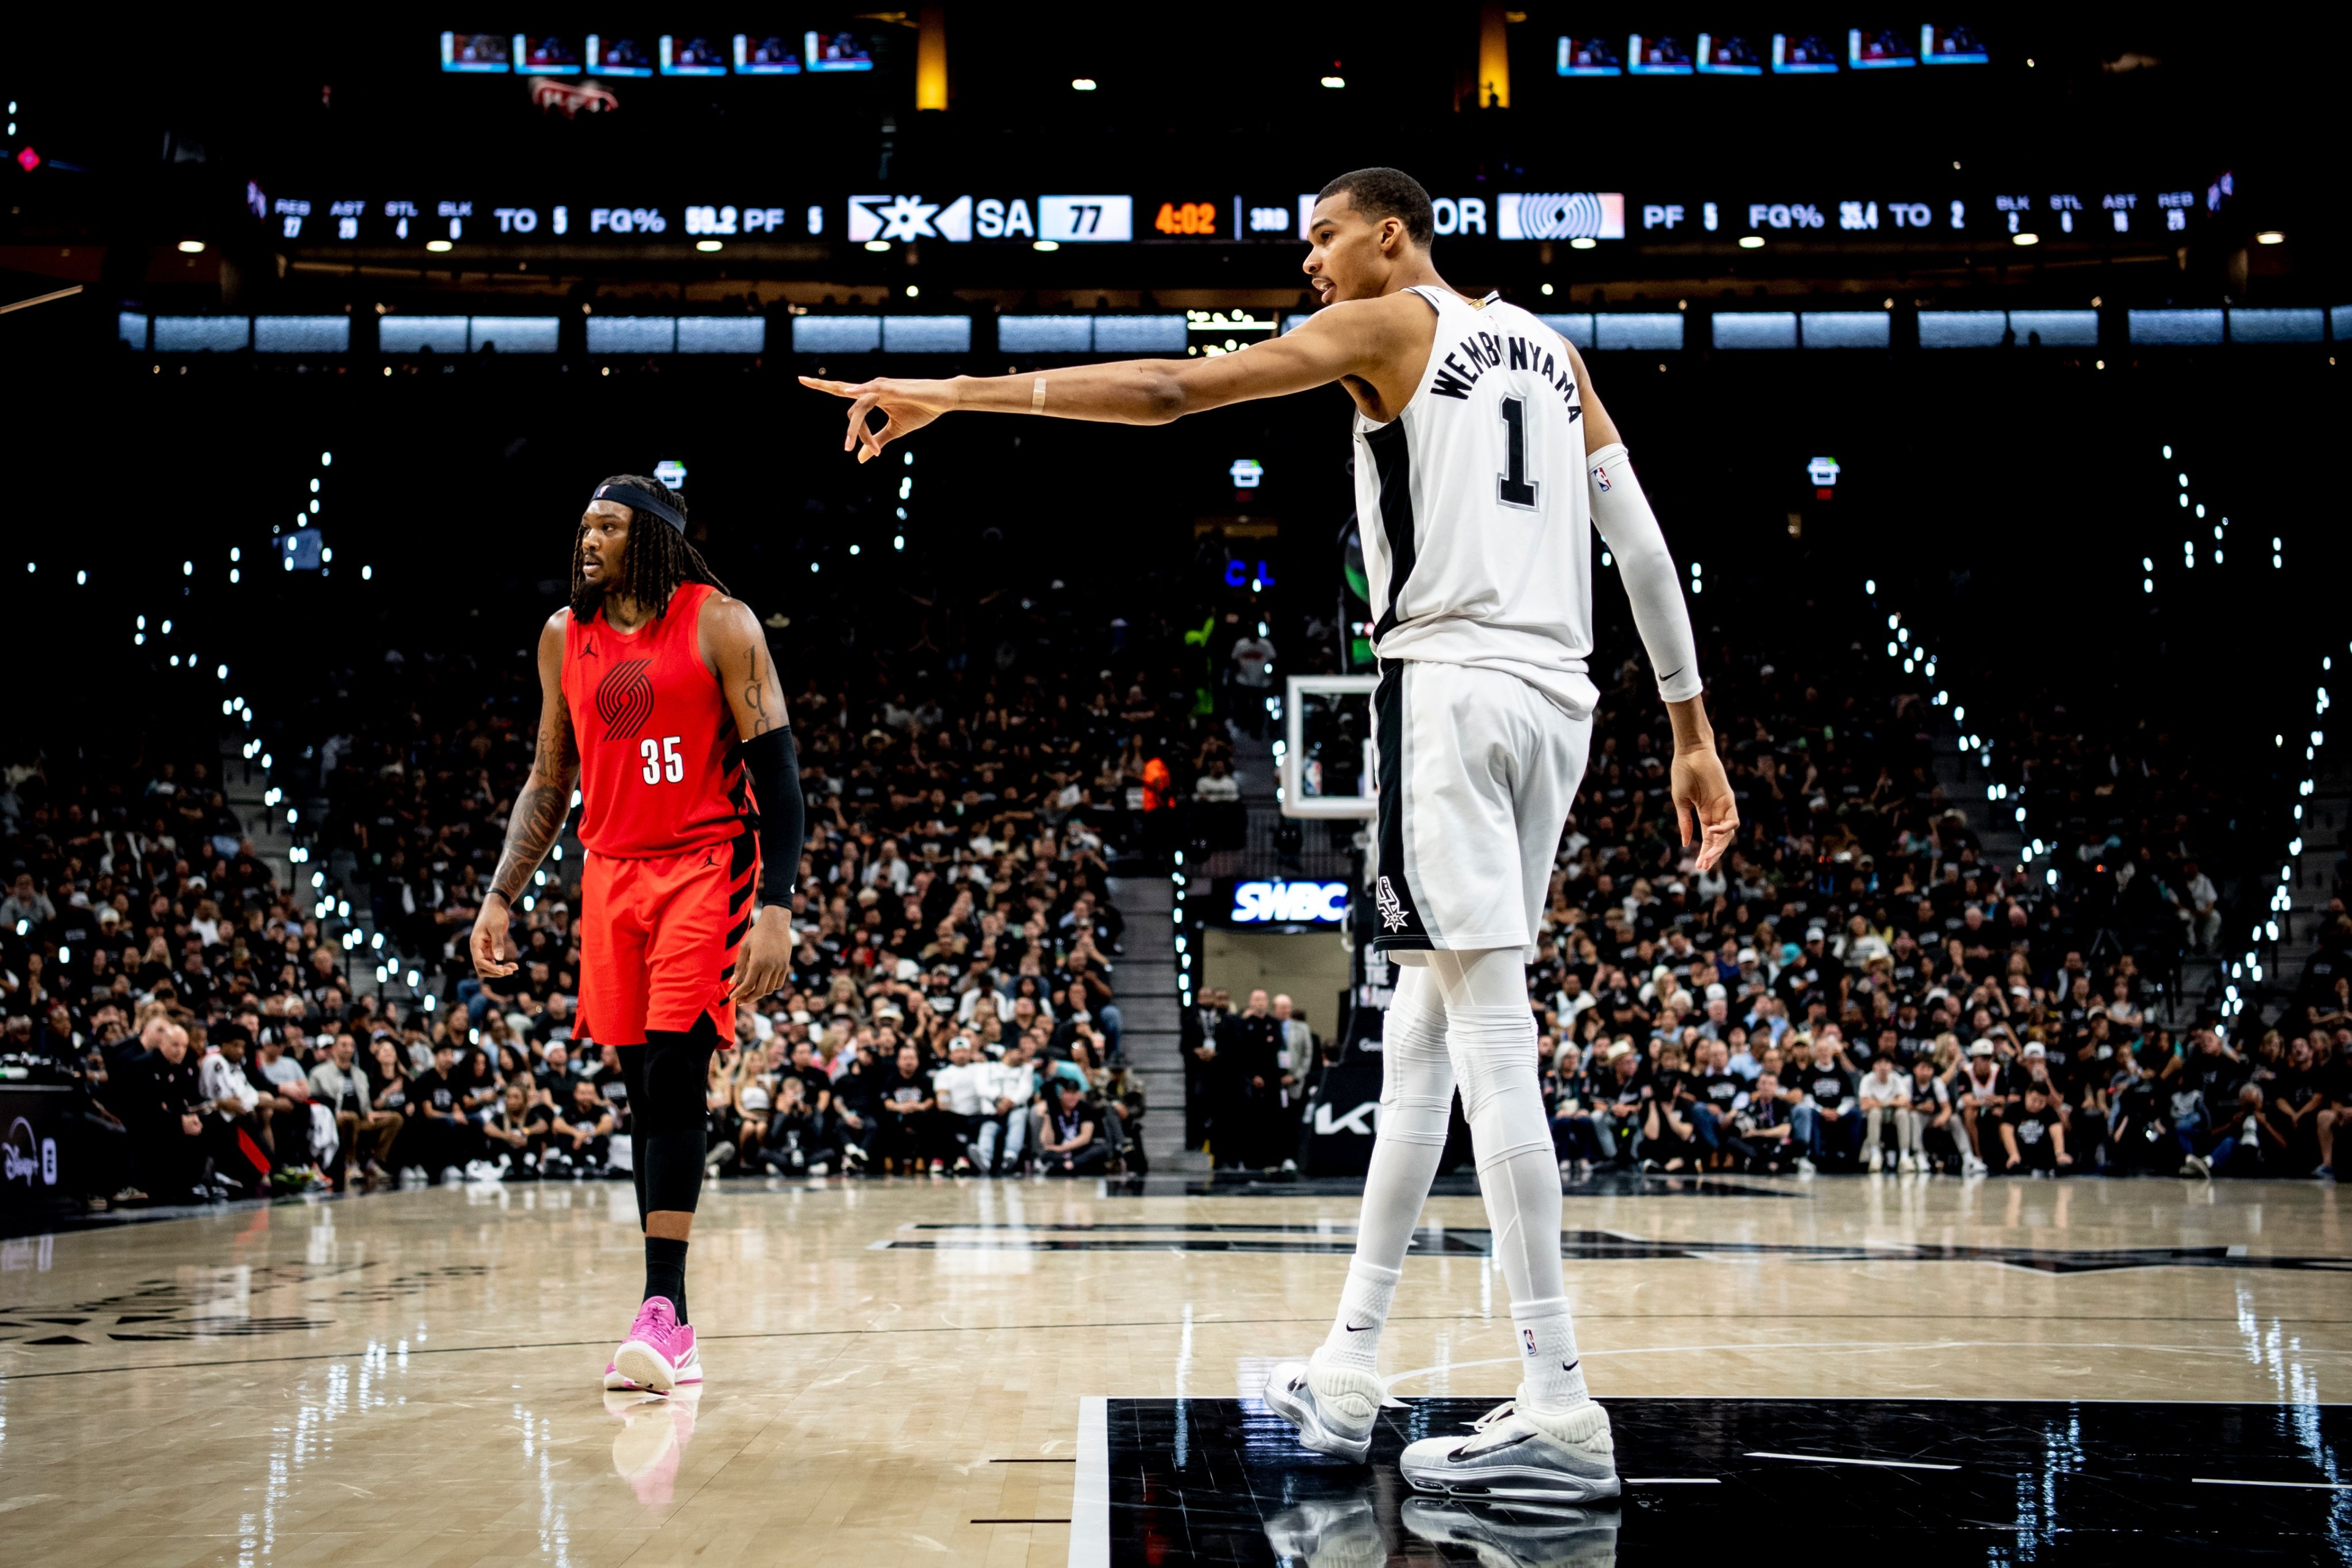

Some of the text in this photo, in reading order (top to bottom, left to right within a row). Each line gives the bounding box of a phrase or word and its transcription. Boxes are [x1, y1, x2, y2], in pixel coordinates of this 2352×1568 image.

[330, 201, 364, 216] AST
[385, 202, 418, 216] STL
[439, 202, 472, 216] BLK
[1434, 198, 1486, 235] OR
[1643, 205, 1684, 228] PF
[1749, 204, 1825, 228] FG%
[1889, 203, 1931, 227] TO
[1951, 200, 1964, 228] 2
[1996, 196, 2029, 210] BLK
[2051, 195, 2082, 209] STL
[2103, 195, 2136, 208] AST
[494, 208, 537, 232] TO
[591, 208, 666, 232] FG%
[744, 208, 784, 232] PF
[976, 199, 1034, 238] SA
[1068, 205, 1102, 234] 77
[1155, 203, 1215, 234] 4:02
[1250, 208, 1289, 231] 3RD
[1496, 391, 1540, 512] 1
[640, 736, 684, 785] 35
[1231, 881, 1349, 921] SWBC
